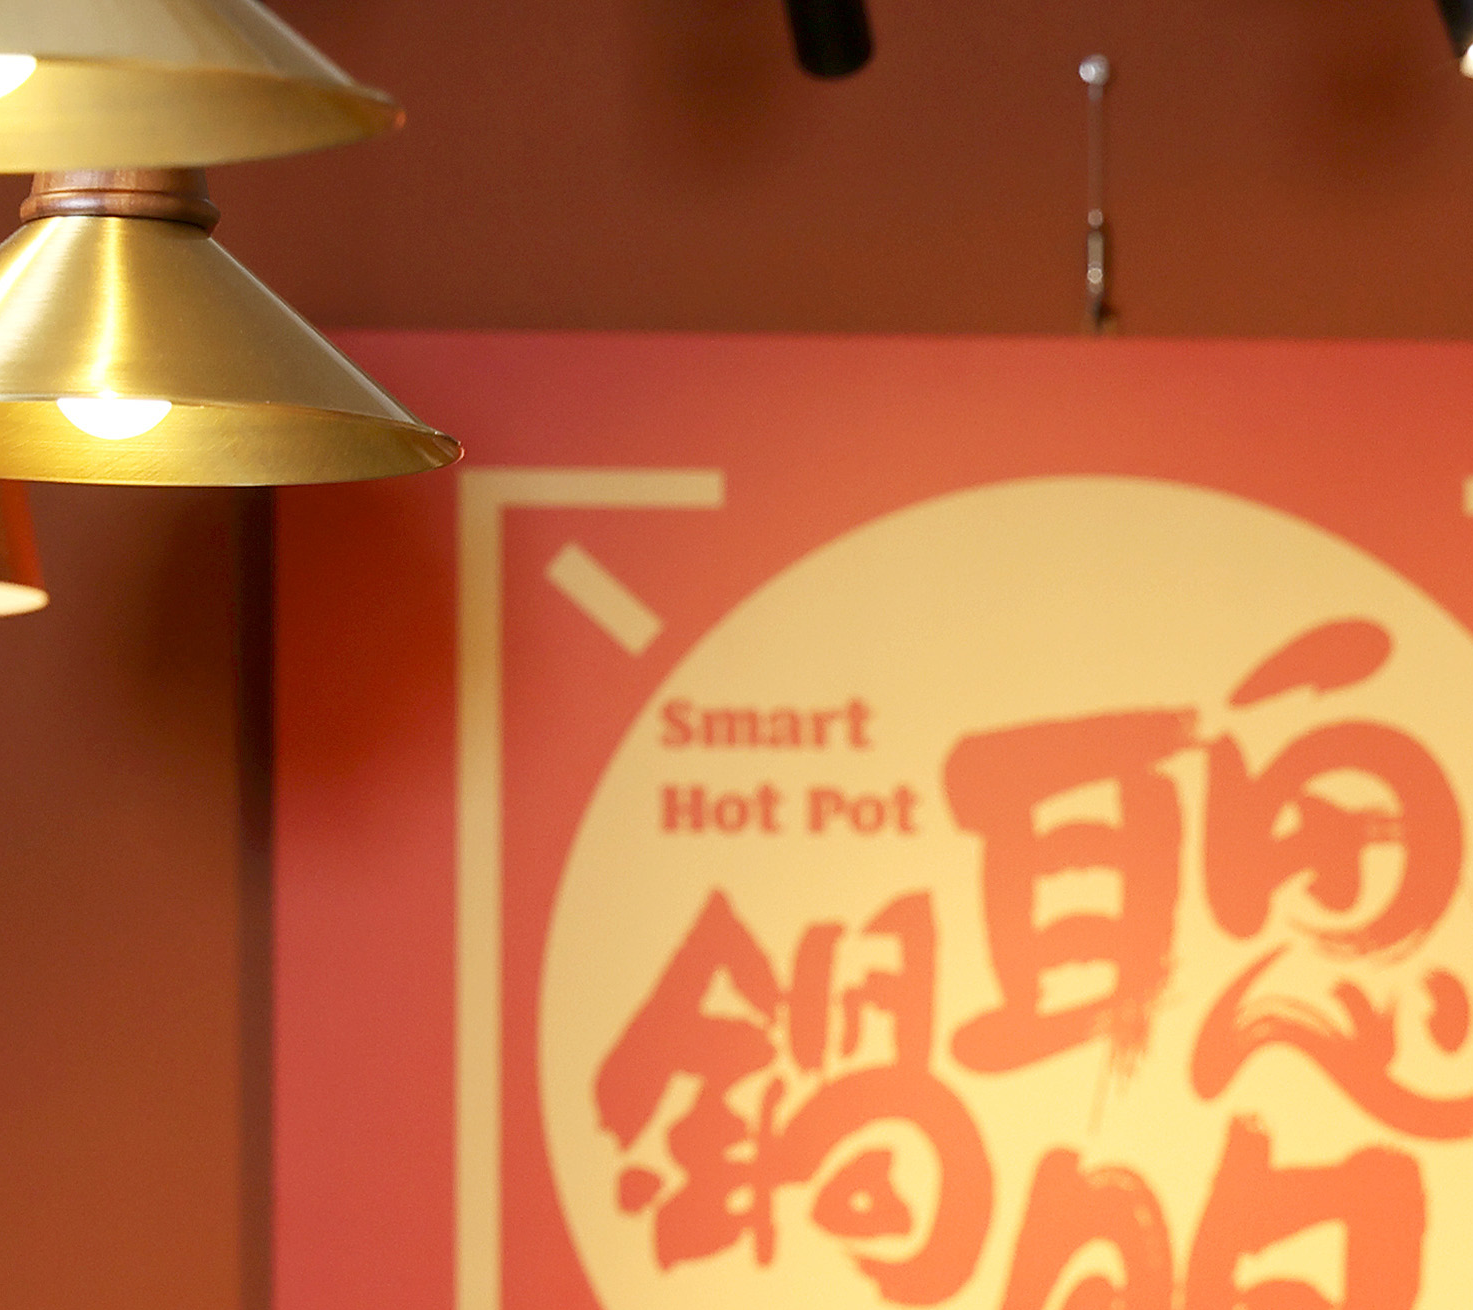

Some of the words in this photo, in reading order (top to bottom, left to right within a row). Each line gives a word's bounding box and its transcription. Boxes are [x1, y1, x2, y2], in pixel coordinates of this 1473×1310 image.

[658, 696, 872, 750] Smart
[659, 783, 782, 837] Hot
[806, 783, 919, 837] Pot
